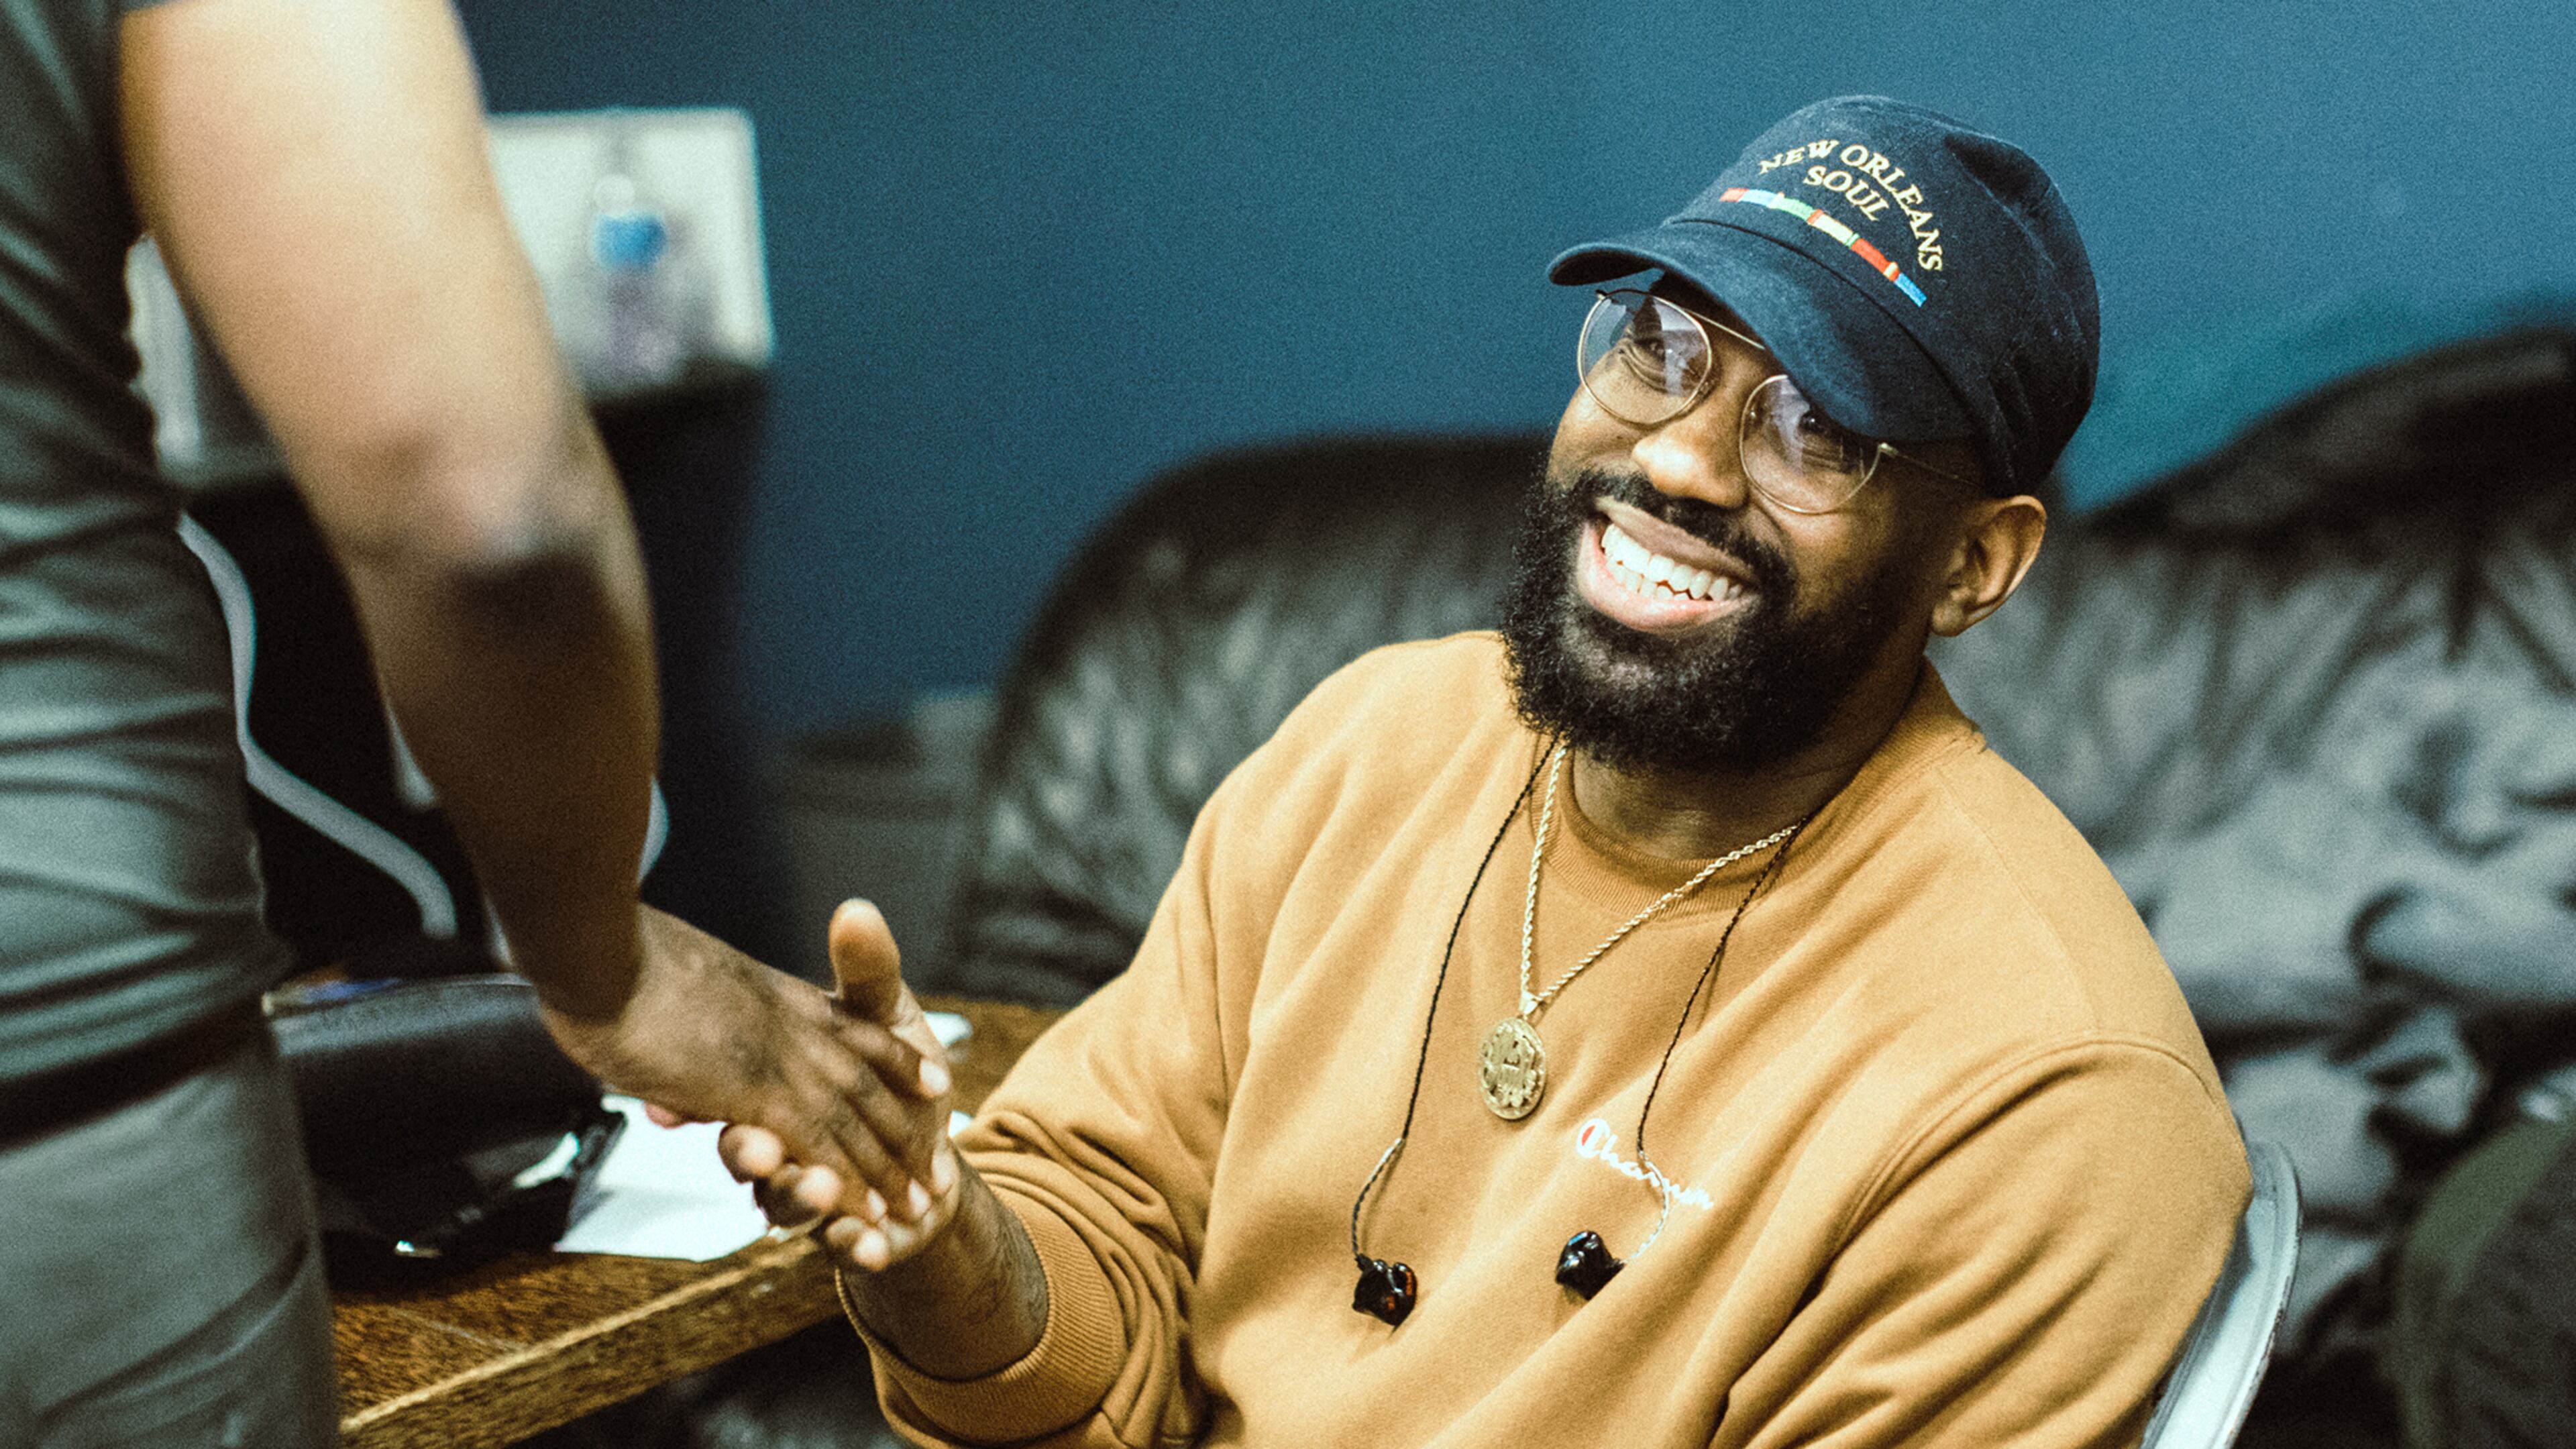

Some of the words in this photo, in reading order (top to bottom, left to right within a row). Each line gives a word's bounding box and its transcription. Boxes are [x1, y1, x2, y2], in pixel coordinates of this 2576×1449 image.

[1758, 139, 1839, 175] NEW
[1840, 144, 1943, 271] ORLEANS
[1803, 165, 1890, 222] SOUL
